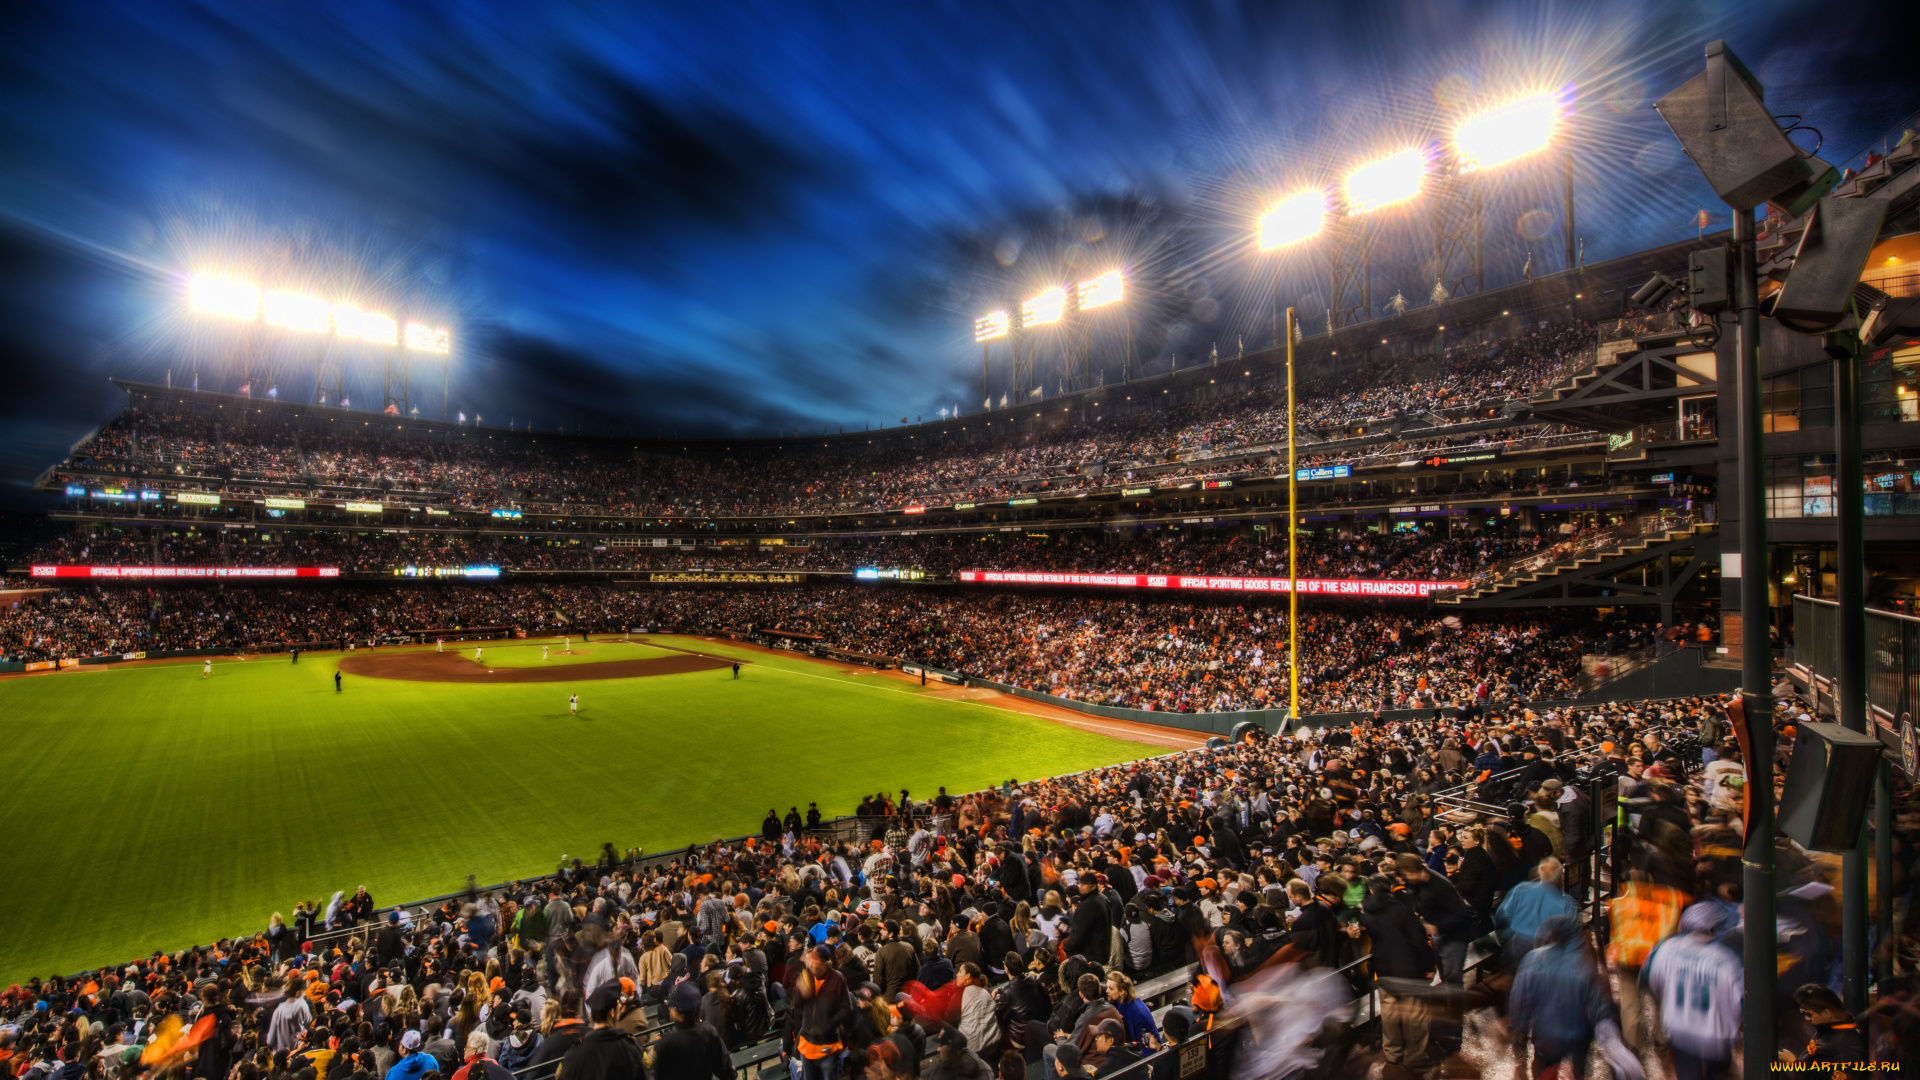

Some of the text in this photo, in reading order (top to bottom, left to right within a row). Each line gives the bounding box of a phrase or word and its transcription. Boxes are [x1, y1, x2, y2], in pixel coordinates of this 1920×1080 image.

[1311, 469, 1333, 477] Colliers
[90, 567, 119, 576] OFFICIAL
[121, 568, 153, 576] SPORTING
[154, 568, 176, 576] GOODS
[177, 568, 206, 576] RETAILER
[1004, 574, 1027, 582] SPORTING
[1044, 575, 1064, 583] RETAILER
[1090, 576, 1117, 585] FRANCISCO
[1118, 577, 1137, 586] GIANTS
[1180, 578, 1208, 588] OFFICIAL
[1209, 579, 1243, 589] SPORTING
[1244, 580, 1269, 590] GOODS
[1270, 580, 1307, 591] RETAIER
[1309, 581, 1320, 591] OF
[1322, 581, 1339, 592] THE
[1340, 582, 1359, 593] SAN
[1361, 583, 1417, 595] FRANCISCO
[1187, 1047, 1199, 1060] 139
